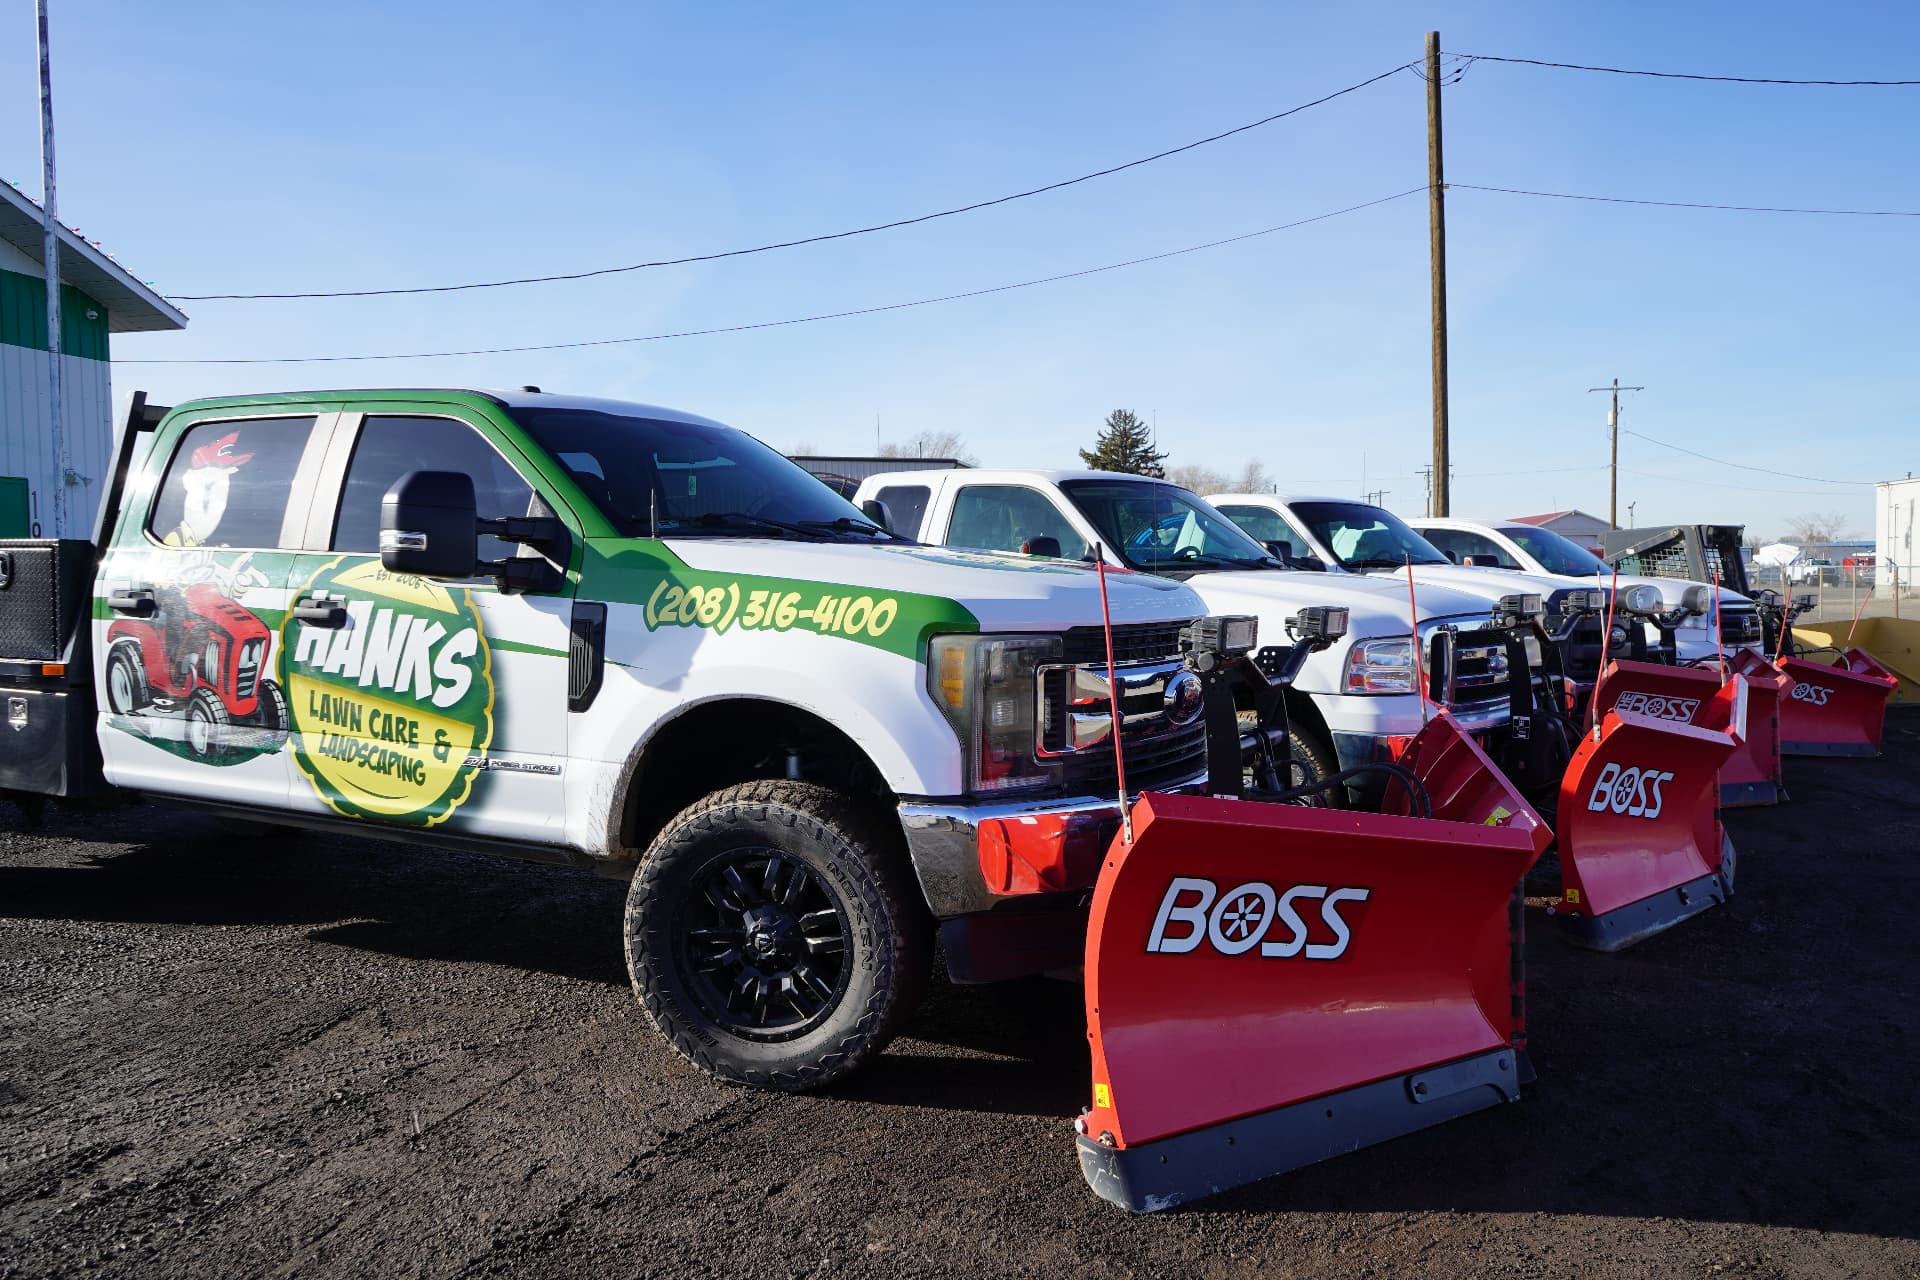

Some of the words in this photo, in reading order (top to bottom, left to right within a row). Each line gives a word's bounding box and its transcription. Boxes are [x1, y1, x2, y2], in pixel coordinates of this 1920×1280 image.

[646, 578, 740, 632] (208)
[743, 590, 897, 637] 316-4100
[294, 589, 478, 708] HANKS
[1629, 695, 1697, 722] BOSS
[1791, 682, 1835, 705] OSS
[309, 689, 363, 732] LAWN
[368, 708, 419, 749] CARE
[433, 728, 451, 763] &
[318, 729, 426, 786] LANDSCAPING
[1587, 762, 1675, 819] BOSS
[826, 861, 873, 971] NEXEN
[1146, 876, 1370, 960] BOSS
